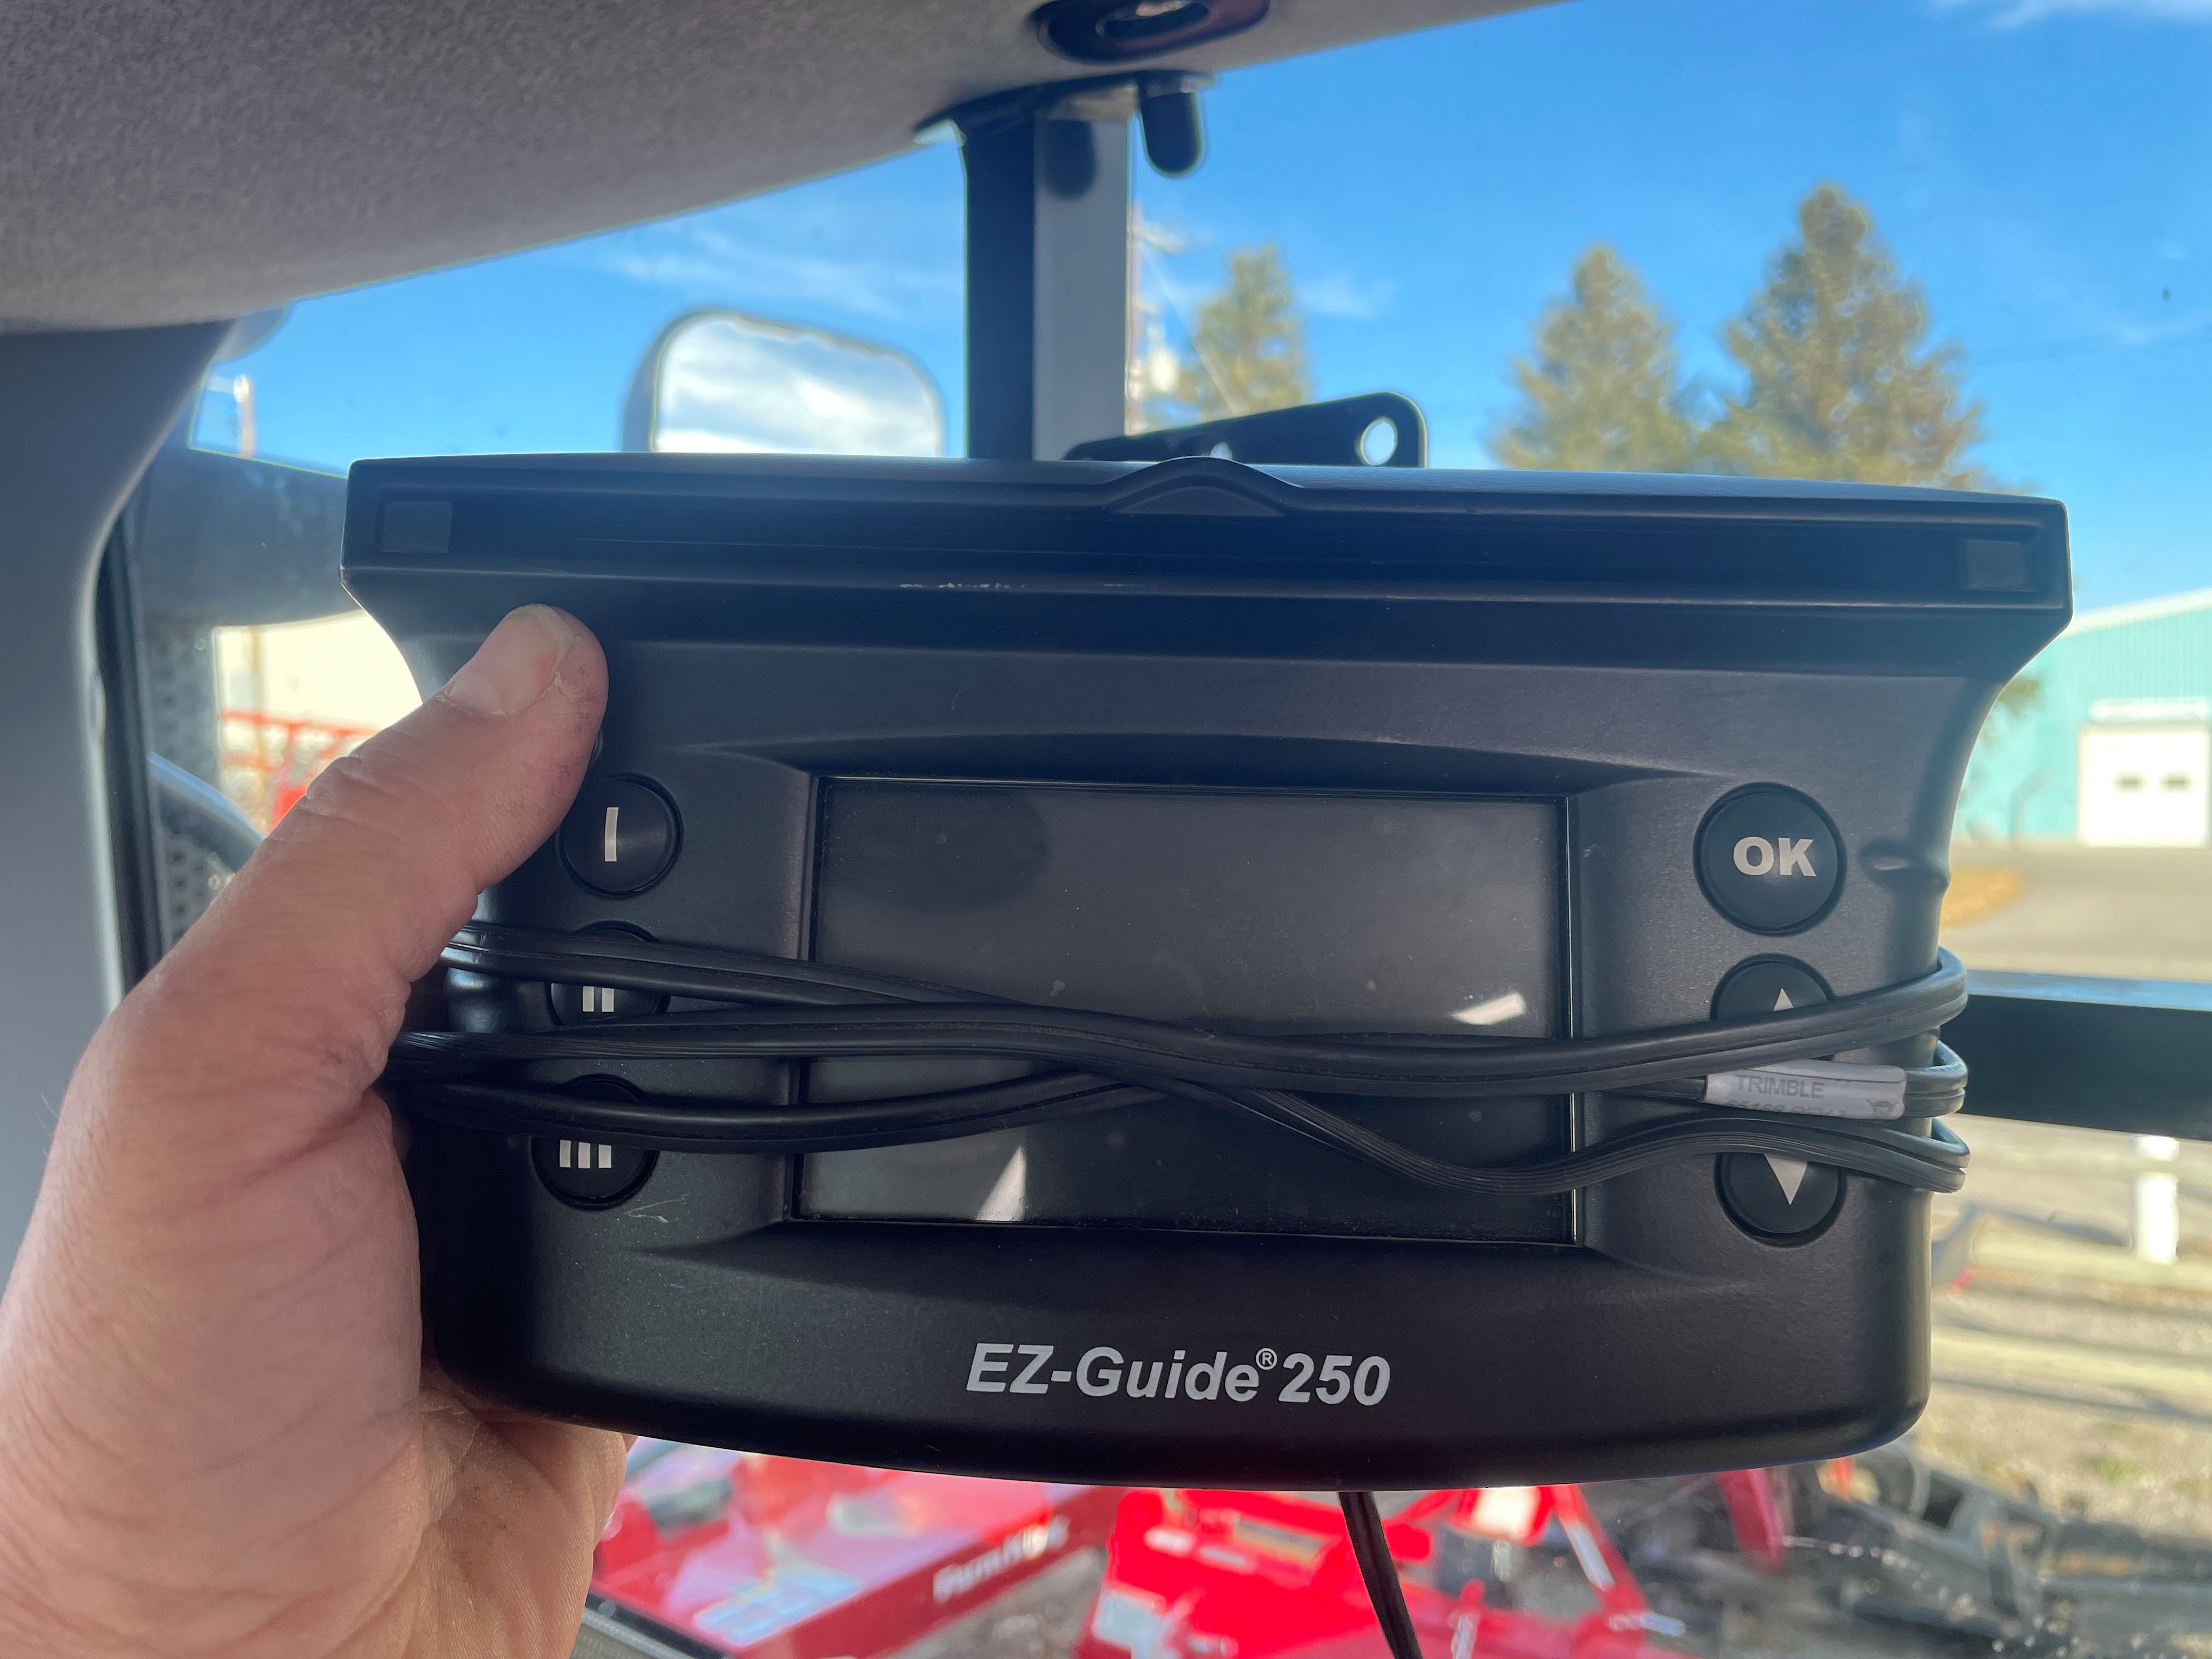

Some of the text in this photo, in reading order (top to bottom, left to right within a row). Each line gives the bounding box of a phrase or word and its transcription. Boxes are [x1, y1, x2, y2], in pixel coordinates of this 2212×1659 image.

[1733, 836, 1817, 877] OK
[1735, 1074, 1825, 1099] TRIMBLE
[1278, 1352, 1391, 1406] 250
